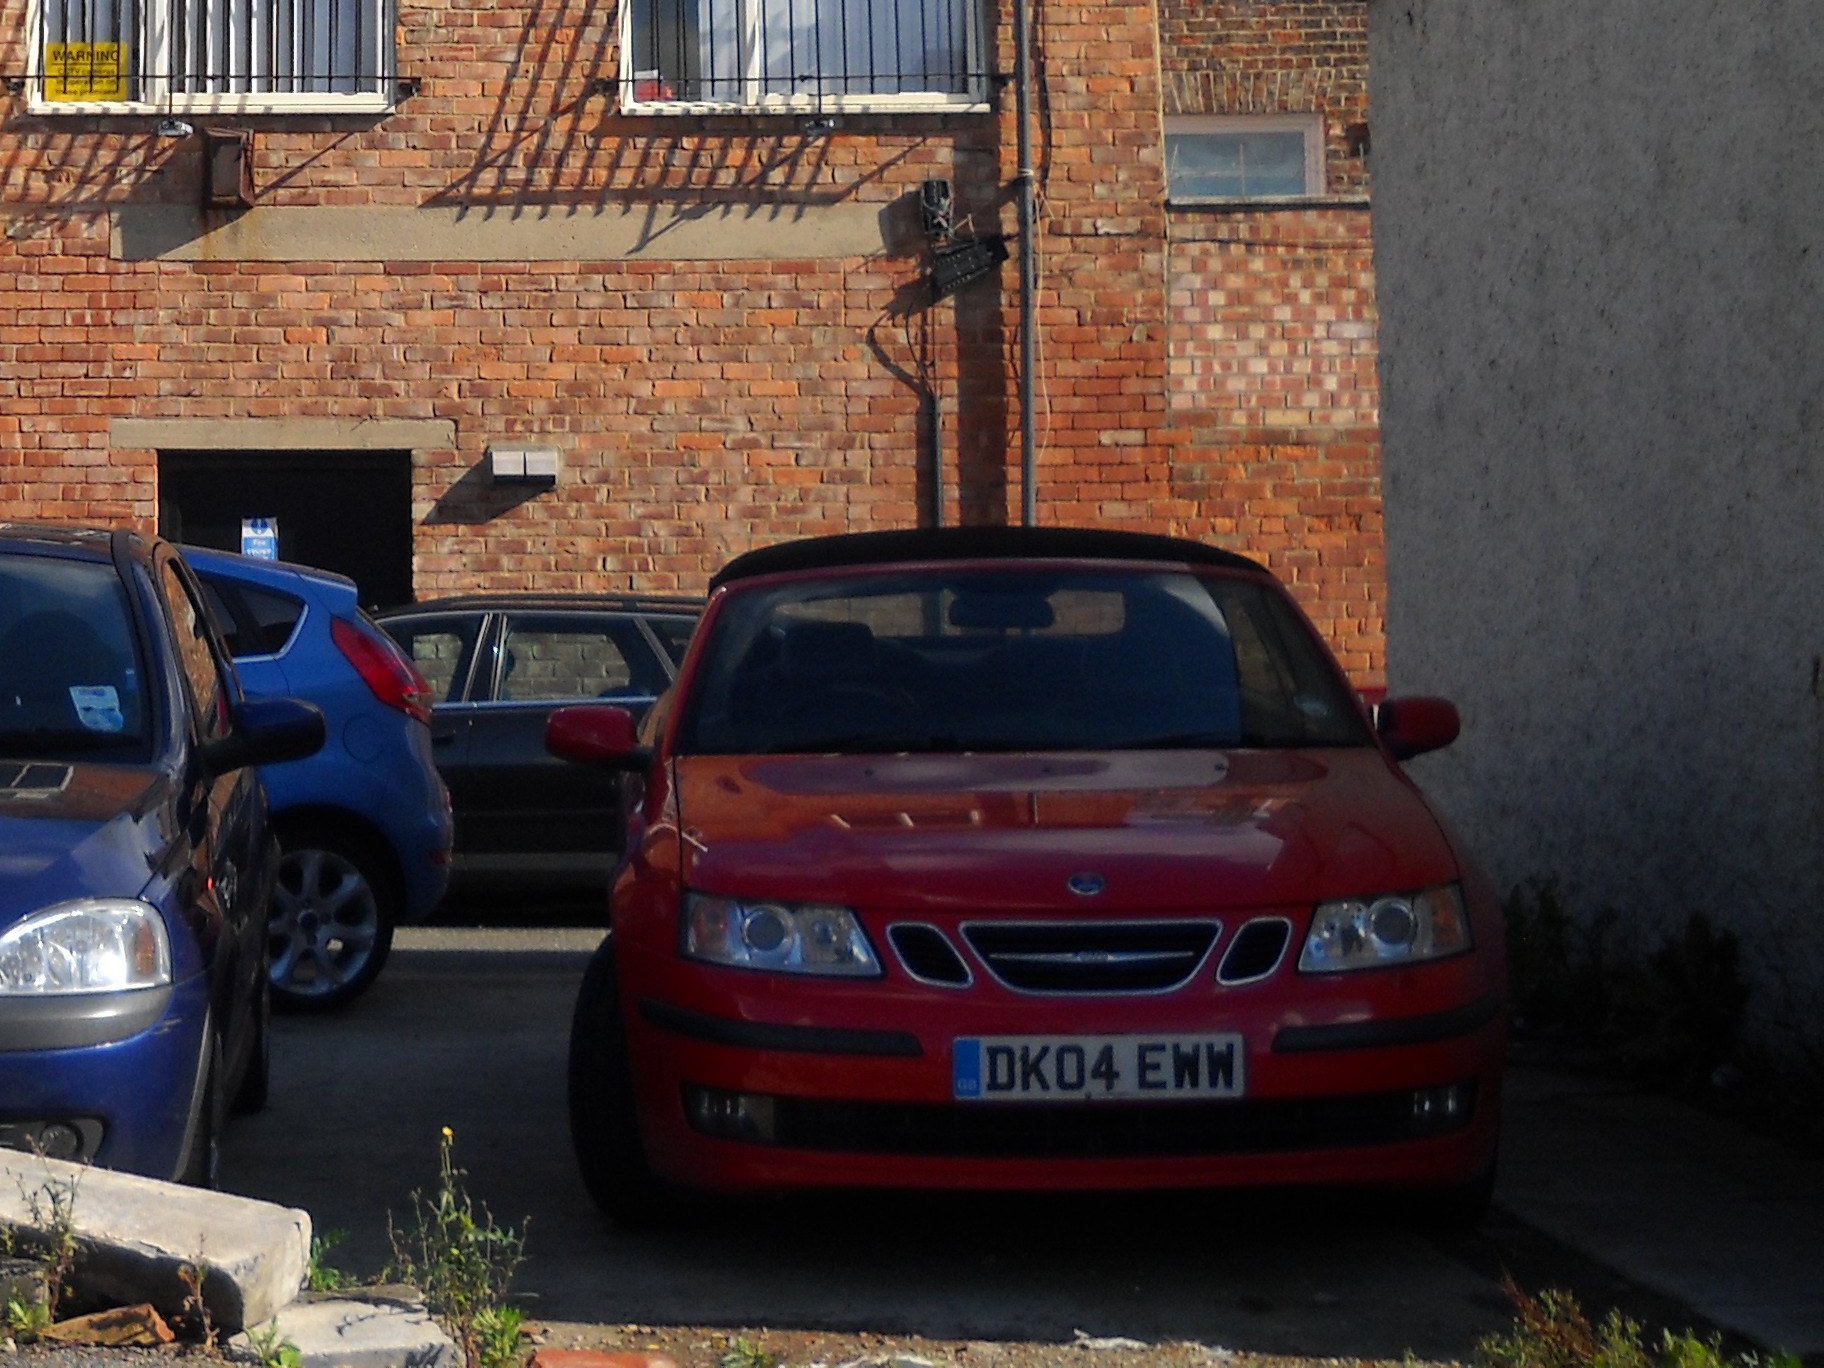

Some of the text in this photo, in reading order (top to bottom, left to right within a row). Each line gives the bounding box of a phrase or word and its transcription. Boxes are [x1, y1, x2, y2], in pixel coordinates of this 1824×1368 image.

[52, 50, 119, 61] WARNING
[986, 1042, 1234, 1092] DK04 EWW
